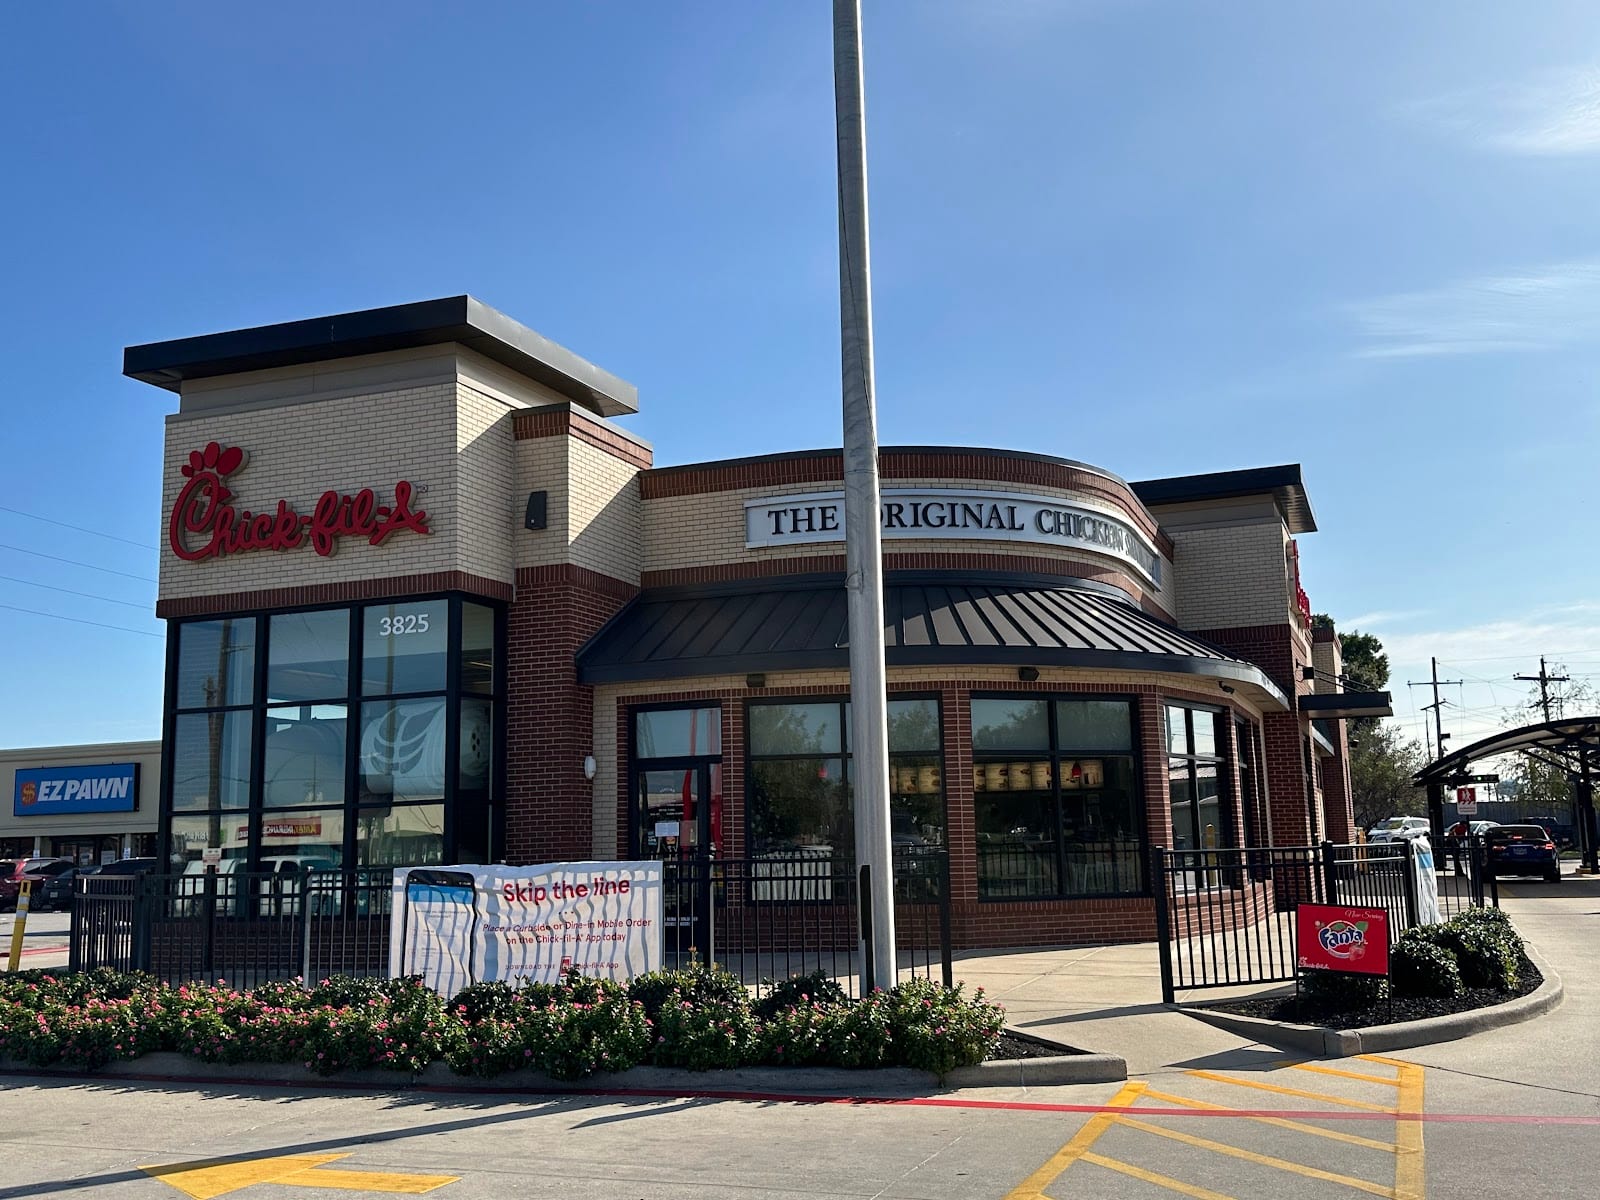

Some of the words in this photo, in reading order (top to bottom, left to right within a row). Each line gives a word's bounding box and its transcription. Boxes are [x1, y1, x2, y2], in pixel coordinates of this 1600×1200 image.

[170, 441, 430, 560] Chick-fil-A
[767, 505, 839, 535] THE
[880, 502, 1024, 531] RIGINAL
[1035, 509, 1124, 552] CHICKEN
[379, 613, 429, 637] 3825
[503, 882, 547, 906] Skip
[552, 880, 589, 900] the
[593, 876, 631, 897] line
[482, 923, 505, 932] Place
[512, 923, 552, 932] Curbside
[565, 920, 595, 930] Dine-in
[597, 919, 624, 929] Mobile
[625, 918, 652, 927] Order
[505, 937, 517, 945] on
[519, 935, 534, 944] the
[585, 933, 601, 944] App
[602, 931, 627, 943] today
[1318, 926, 1364, 951] Fanta
